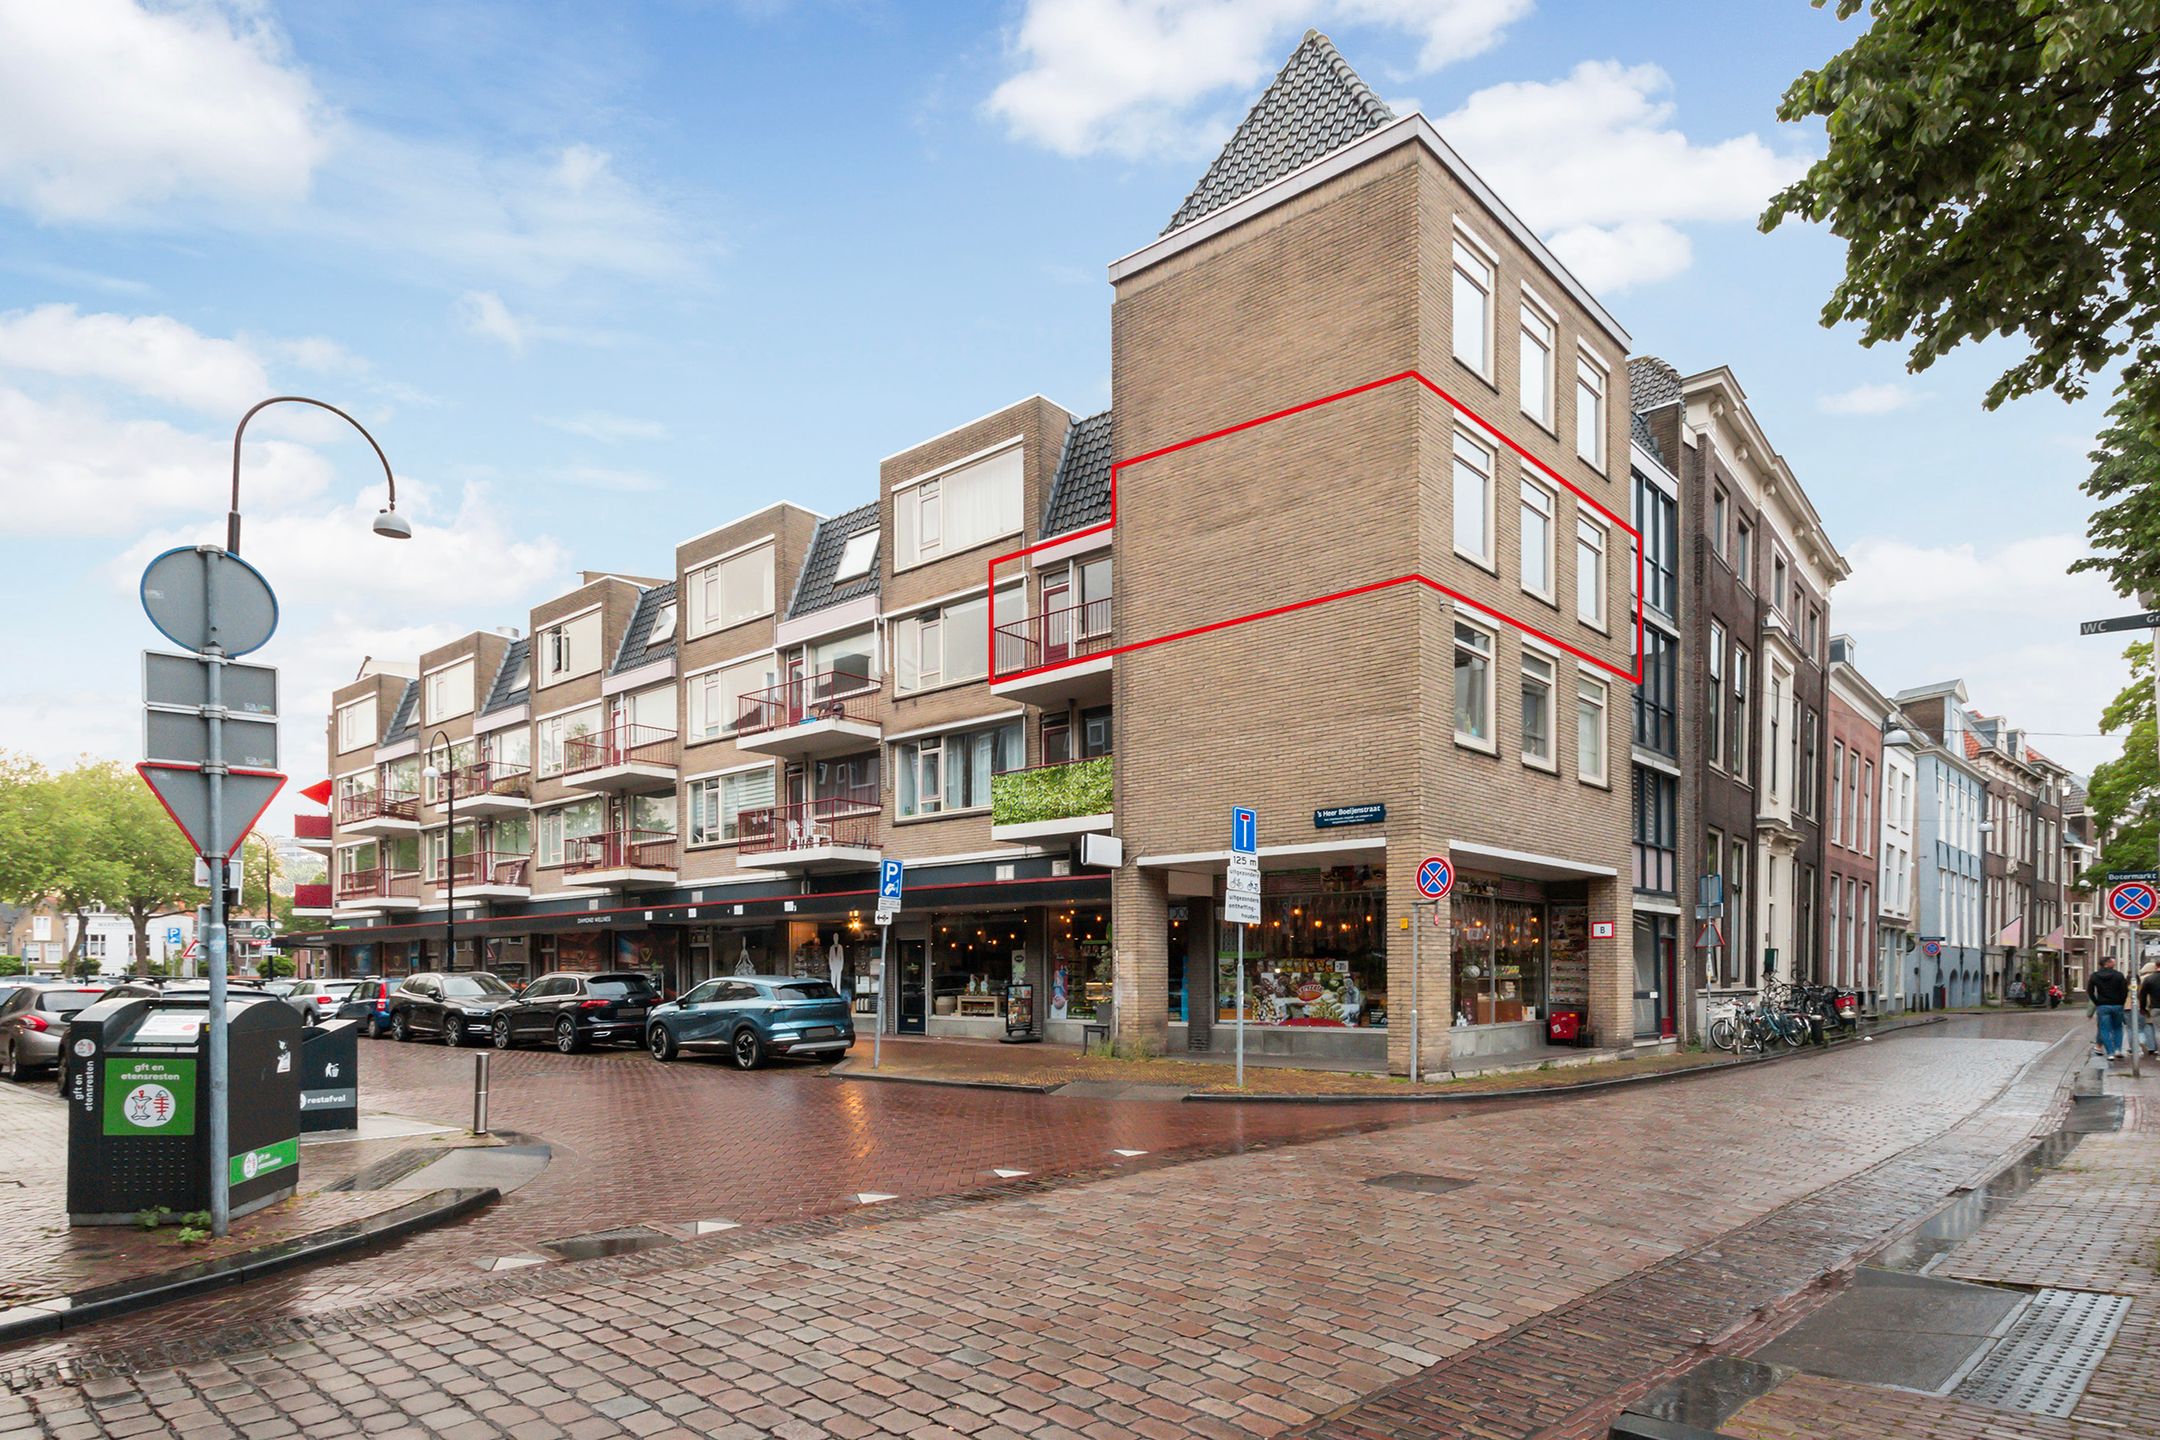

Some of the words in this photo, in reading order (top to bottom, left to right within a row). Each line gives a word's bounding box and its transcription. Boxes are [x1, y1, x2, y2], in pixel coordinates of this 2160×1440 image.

[2082, 621, 2107, 634] WC
[1338, 806, 1381, 815] Boeijenstraat
[1233, 855, 1247, 865] 125
[886, 862, 899, 882] P
[2108, 873, 2157, 881] Botermarkt
[1600, 926, 1605, 934] B
[134, 1063, 149, 1073] gft
[76, 1074, 83, 1085] en
[85, 1061, 94, 1111] etensresten
[73, 1089, 84, 1100] gft
[307, 1095, 346, 1104] restafval
